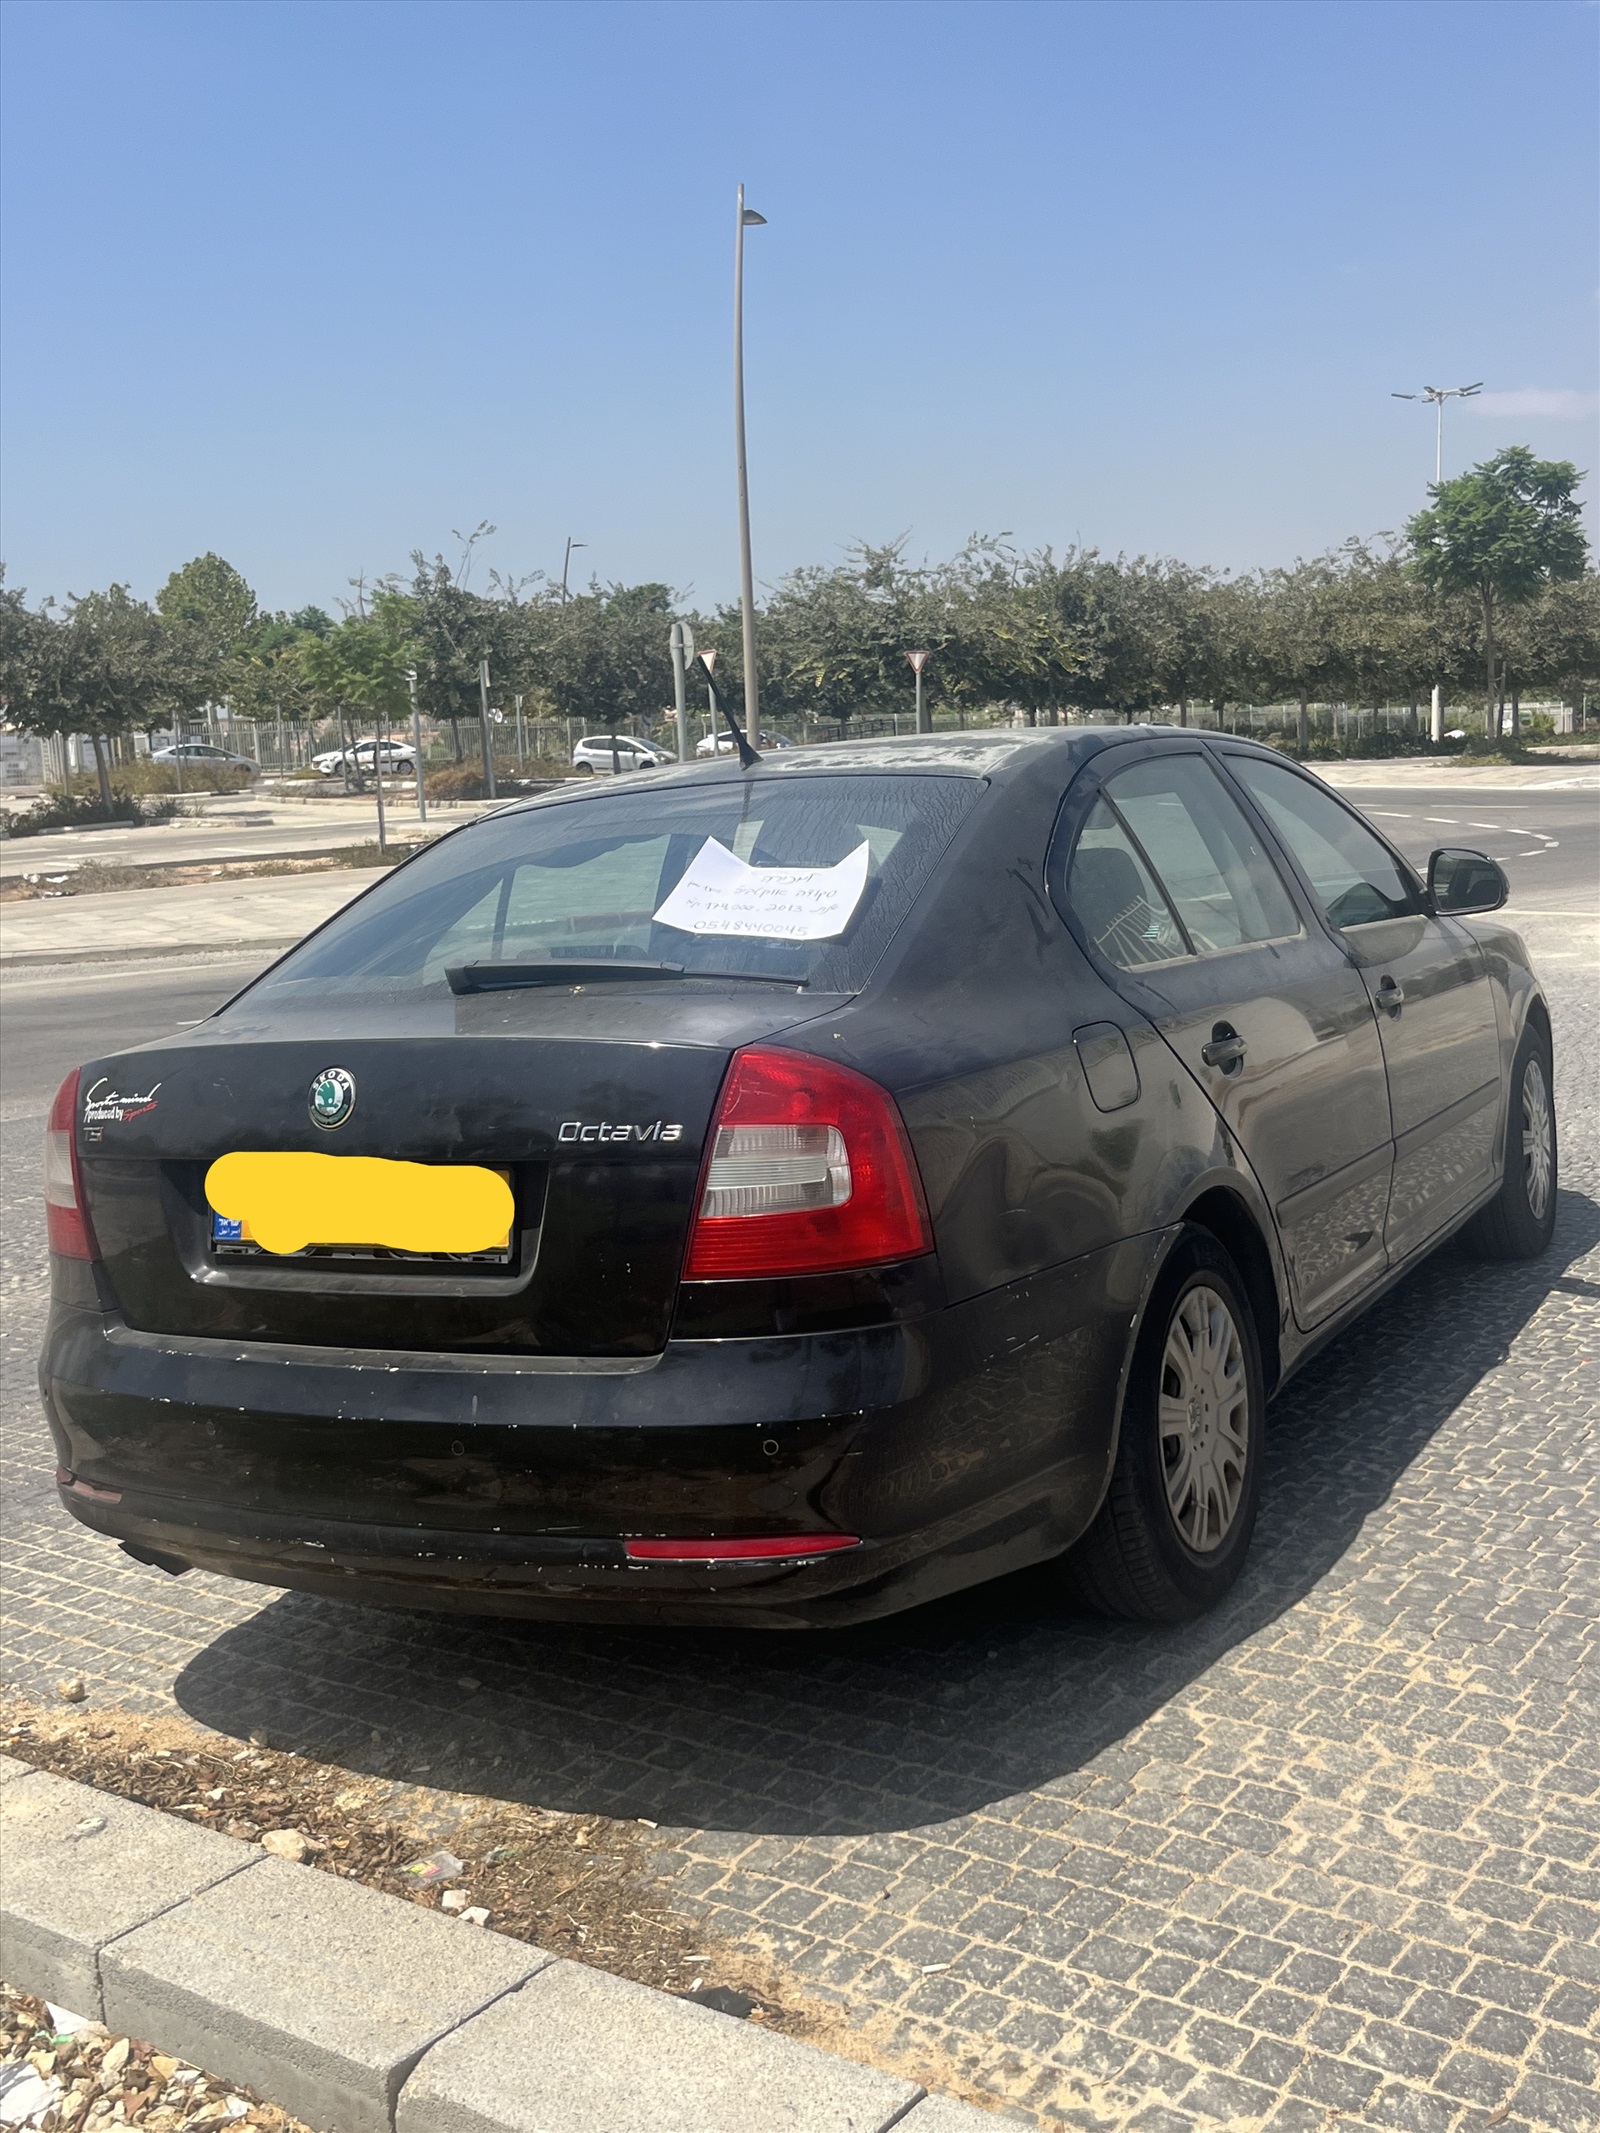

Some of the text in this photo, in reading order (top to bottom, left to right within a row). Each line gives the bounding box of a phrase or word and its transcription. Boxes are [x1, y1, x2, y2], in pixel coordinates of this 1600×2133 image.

[795, 889, 838, 901] סקודה
[693, 920, 808, 937] 0548440045
[115, 1106, 124, 1121] by
[558, 1120, 683, 1141] Octavia
